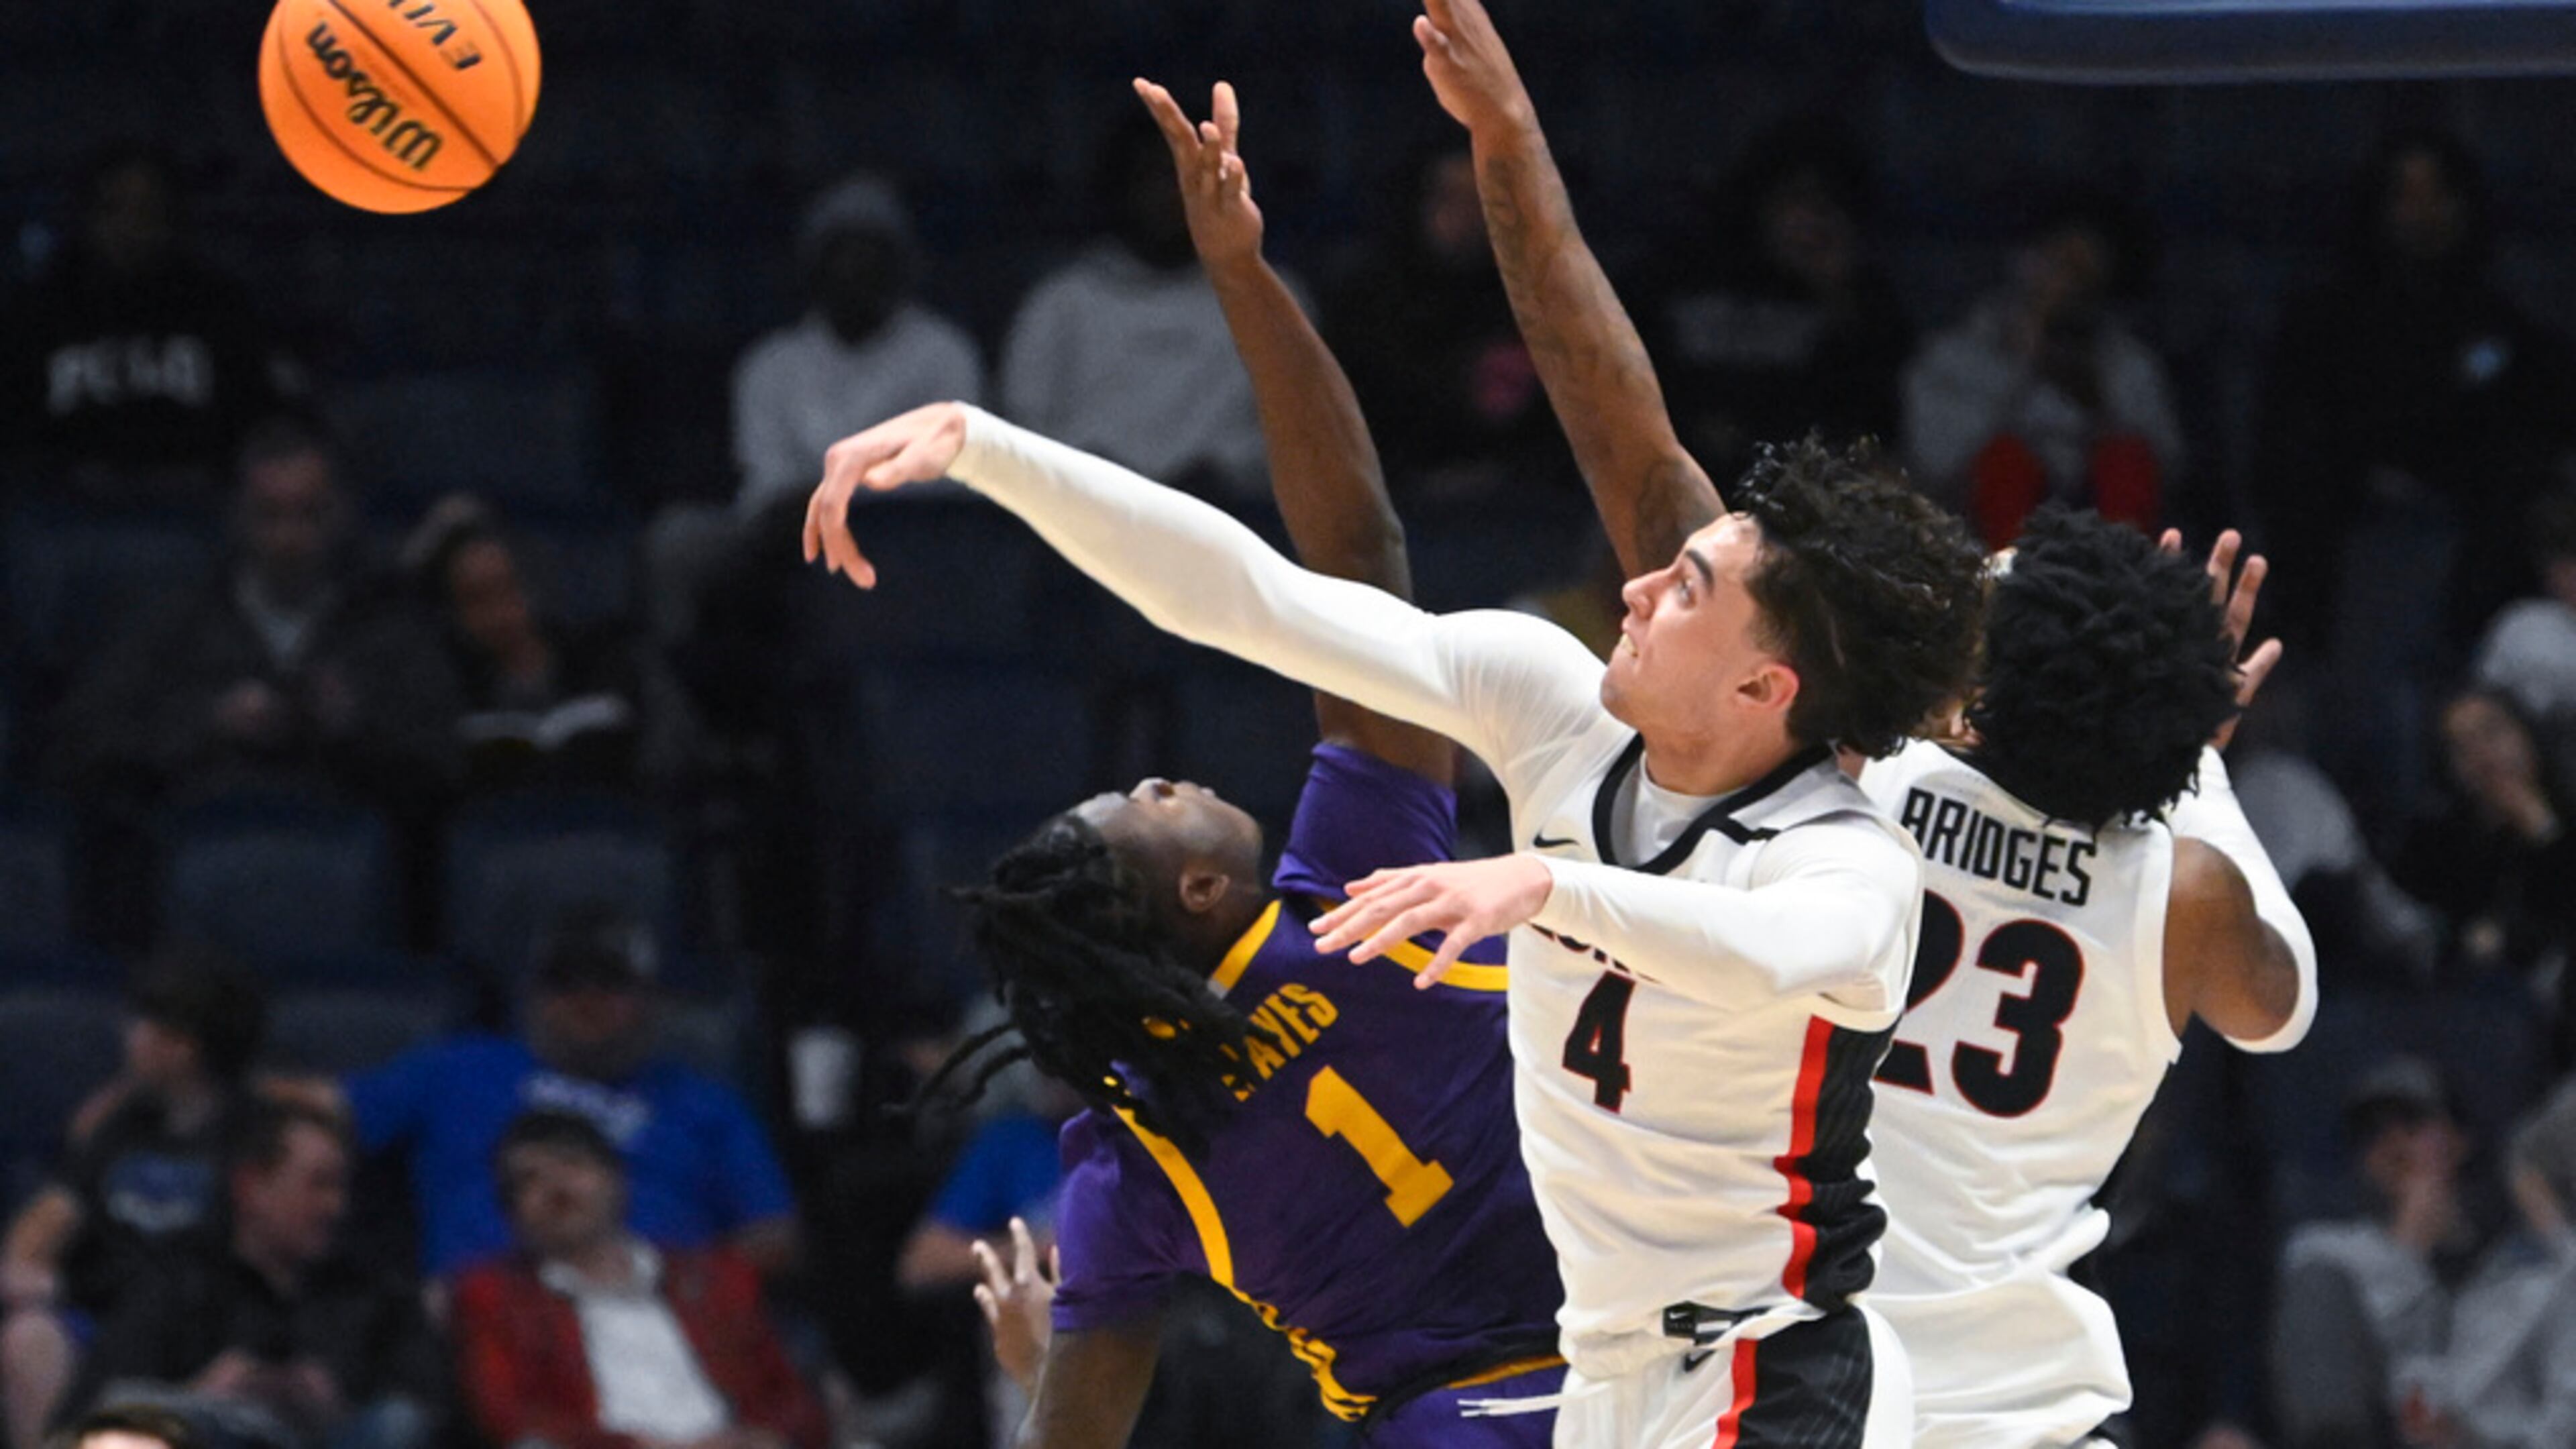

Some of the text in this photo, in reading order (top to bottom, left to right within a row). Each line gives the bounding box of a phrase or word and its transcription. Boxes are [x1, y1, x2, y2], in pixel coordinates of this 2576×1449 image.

[305, 21, 444, 171] Wilson
[1900, 786, 2097, 906] BRIDGES
[1220, 983, 1339, 1102] AYES
[1562, 969, 1636, 1114] 4
[1305, 1065, 1454, 1228] 1
